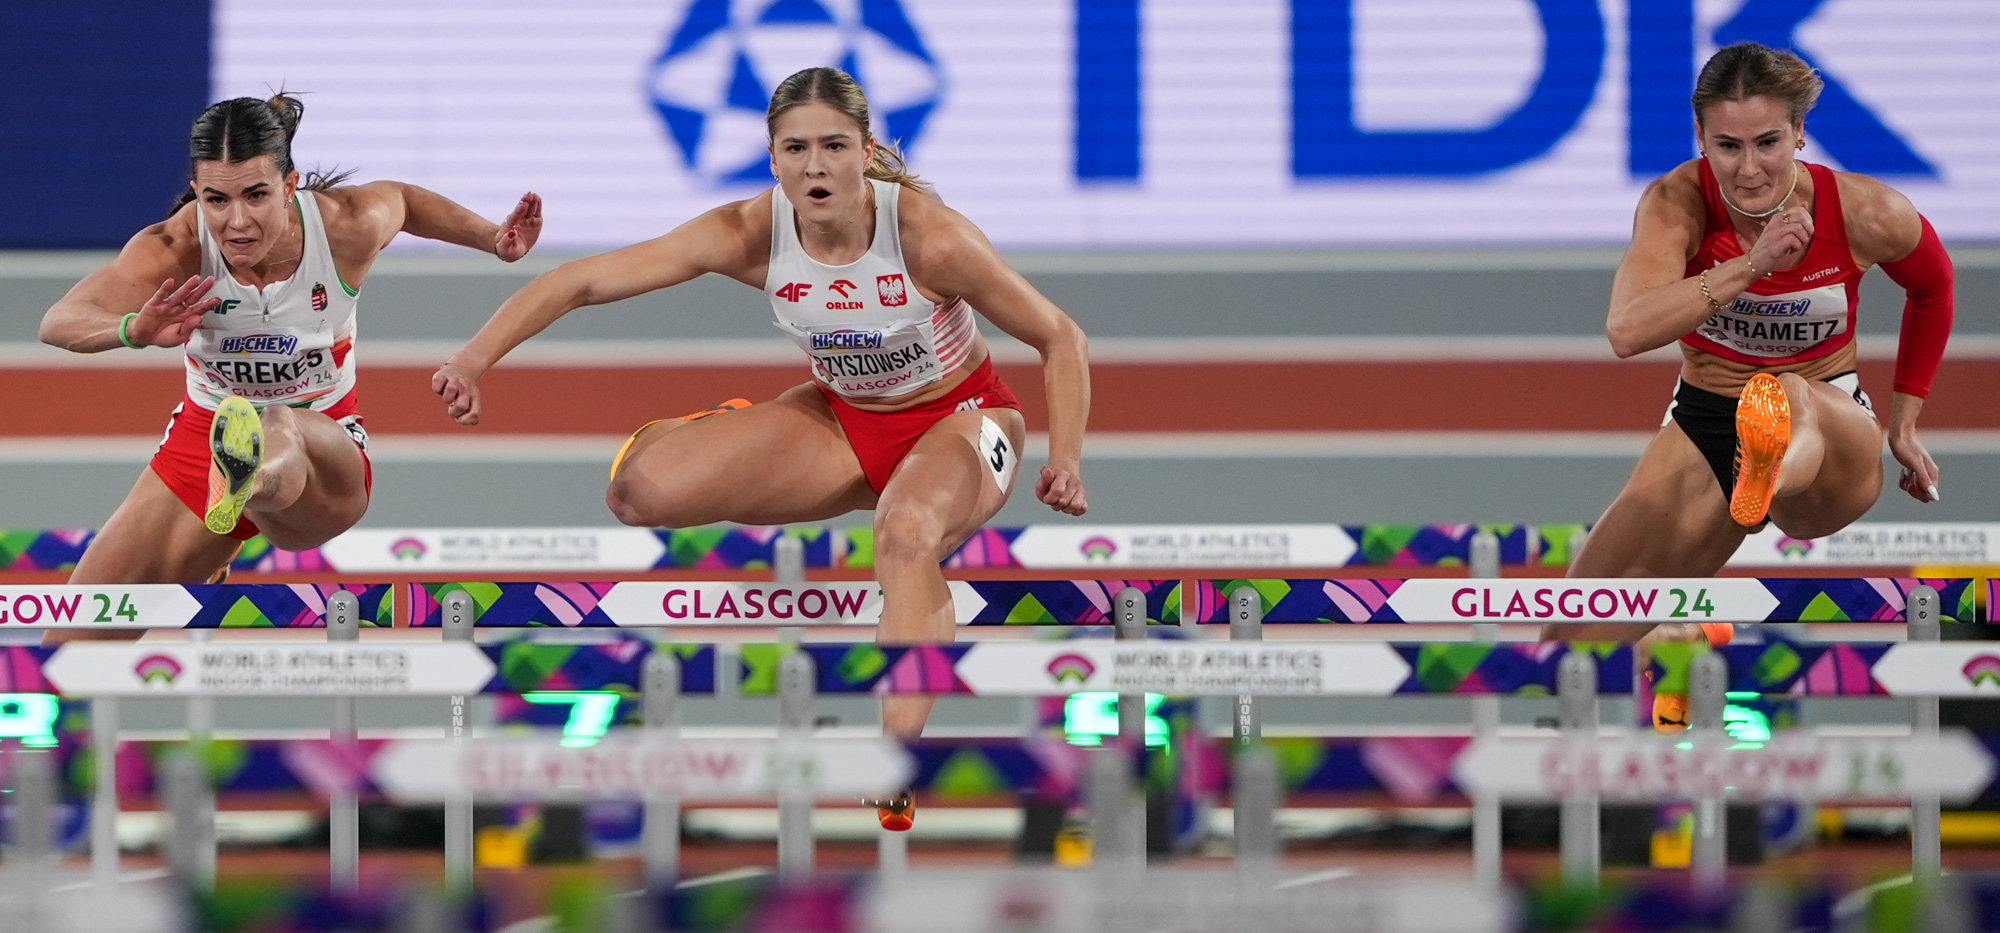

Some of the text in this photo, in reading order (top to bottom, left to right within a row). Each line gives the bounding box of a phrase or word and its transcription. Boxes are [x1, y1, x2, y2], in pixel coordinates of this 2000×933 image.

[1802, 266, 1840, 283] AUSTRIA
[776, 282, 812, 303] 4F
[826, 301, 863, 310] ORLEN
[1731, 298, 1810, 317] HI-CHEW
[1706, 314, 1839, 341] STRAMETZ
[221, 335, 297, 355] HI-CHEW
[810, 330, 882, 350] HI-CHEW
[1734, 340, 1806, 354] GLASGO
[915, 361, 934, 374] 24
[232, 370, 332, 398] GLASGOW 24
[990, 436, 1007, 472] 5
[0, 593, 138, 623] OW 24
[662, 589, 868, 618] GLASGOW
[1451, 587, 1715, 617] GLASGOW 24
[1239, 694, 1252, 746] MONDO
